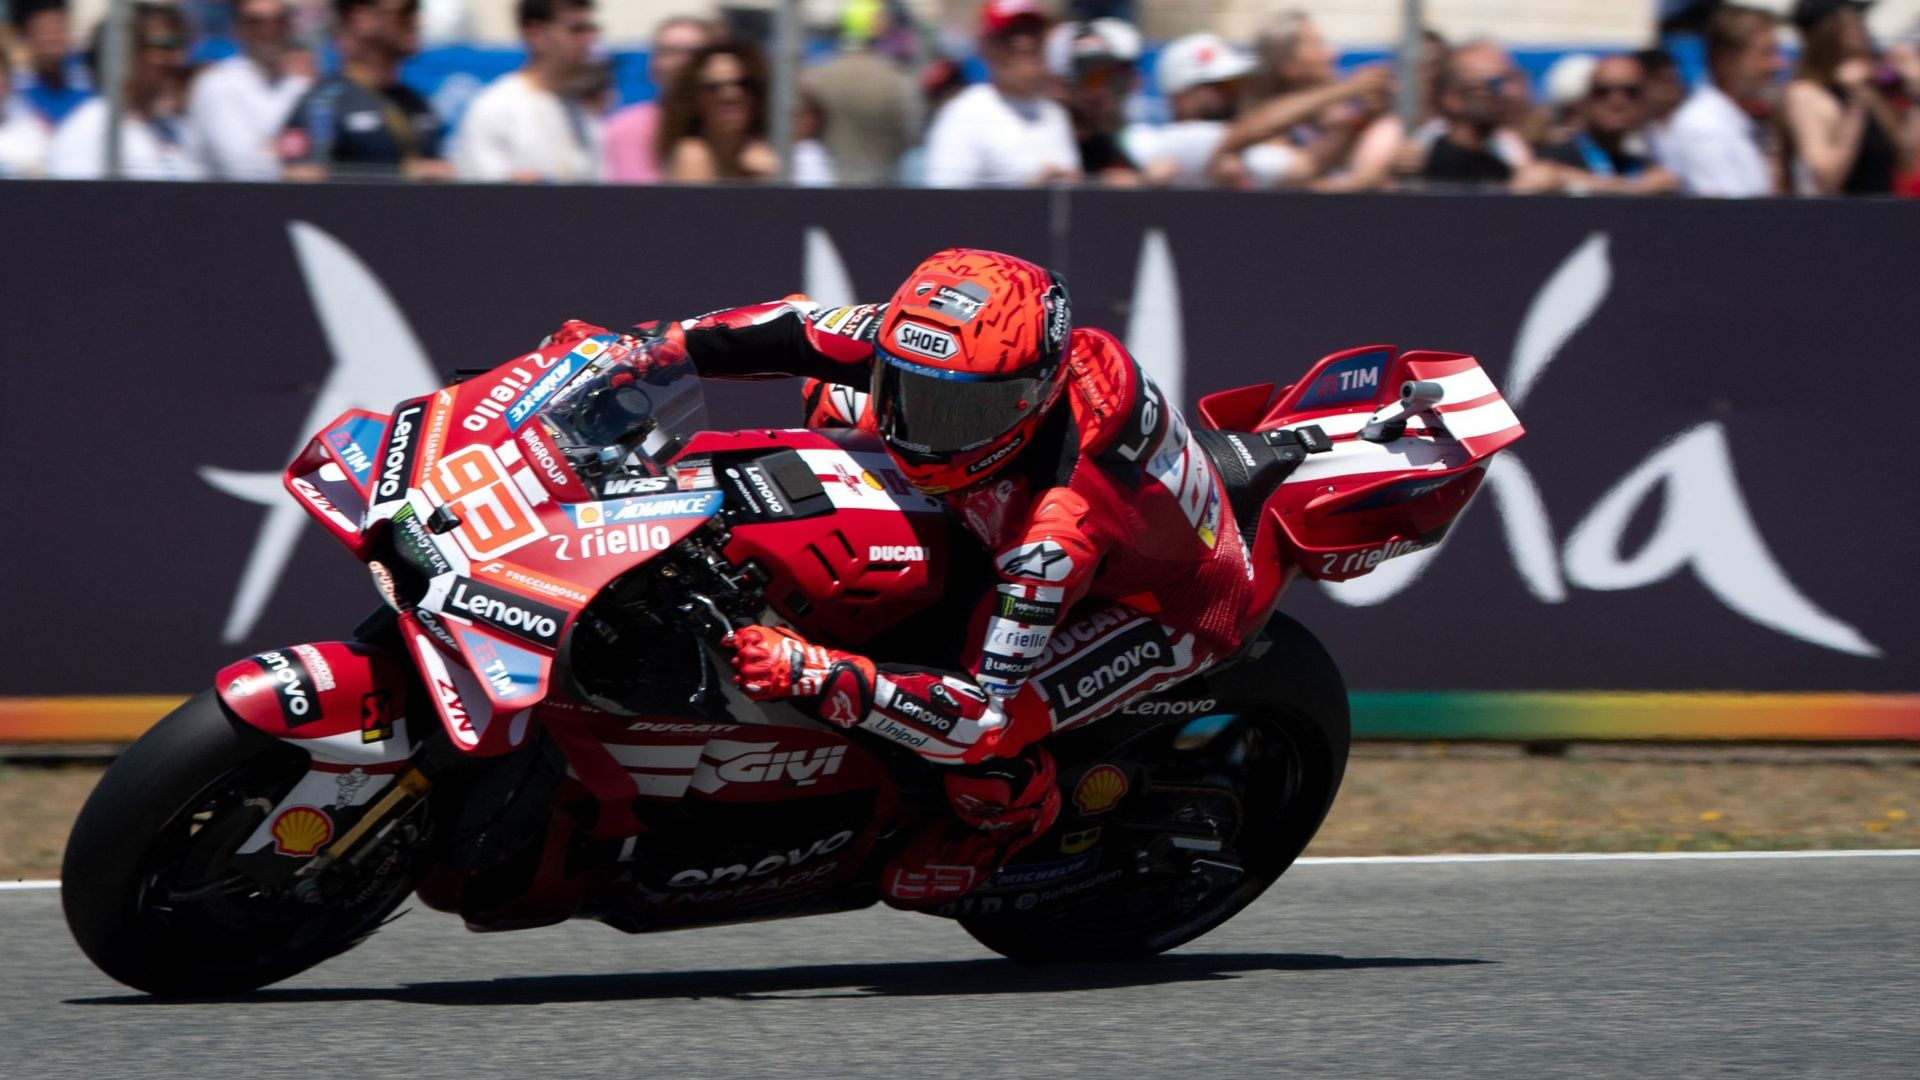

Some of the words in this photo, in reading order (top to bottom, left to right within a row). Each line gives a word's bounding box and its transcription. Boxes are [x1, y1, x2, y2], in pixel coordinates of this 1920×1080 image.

[901, 326, 949, 355] SHOEI
[1340, 366, 1379, 391] TIM
[463, 367, 534, 432] riello
[340, 443, 371, 473] TIM
[380, 407, 421, 497] Lenovo
[970, 437, 1022, 472] Lenovo
[603, 475, 670, 495] WRS
[746, 466, 784, 514] Lenovo
[613, 498, 708, 521] ADVANCE
[581, 523, 671, 559] riello
[868, 546, 930, 562] DUCATI
[505, 571, 587, 602] FRECCIAROSSA
[451, 583, 557, 637] Lenovo
[1005, 632, 1046, 648] riello
[256, 651, 309, 716] enovo
[485, 659, 517, 696] TIM
[1057, 640, 1161, 709] Lenovo
[892, 693, 950, 731] Lenovo
[1121, 699, 1216, 716] Lenovo
[626, 721, 744, 733] DUCATI
[876, 718, 930, 748] Unipol
[718, 744, 848, 786] GIVI
